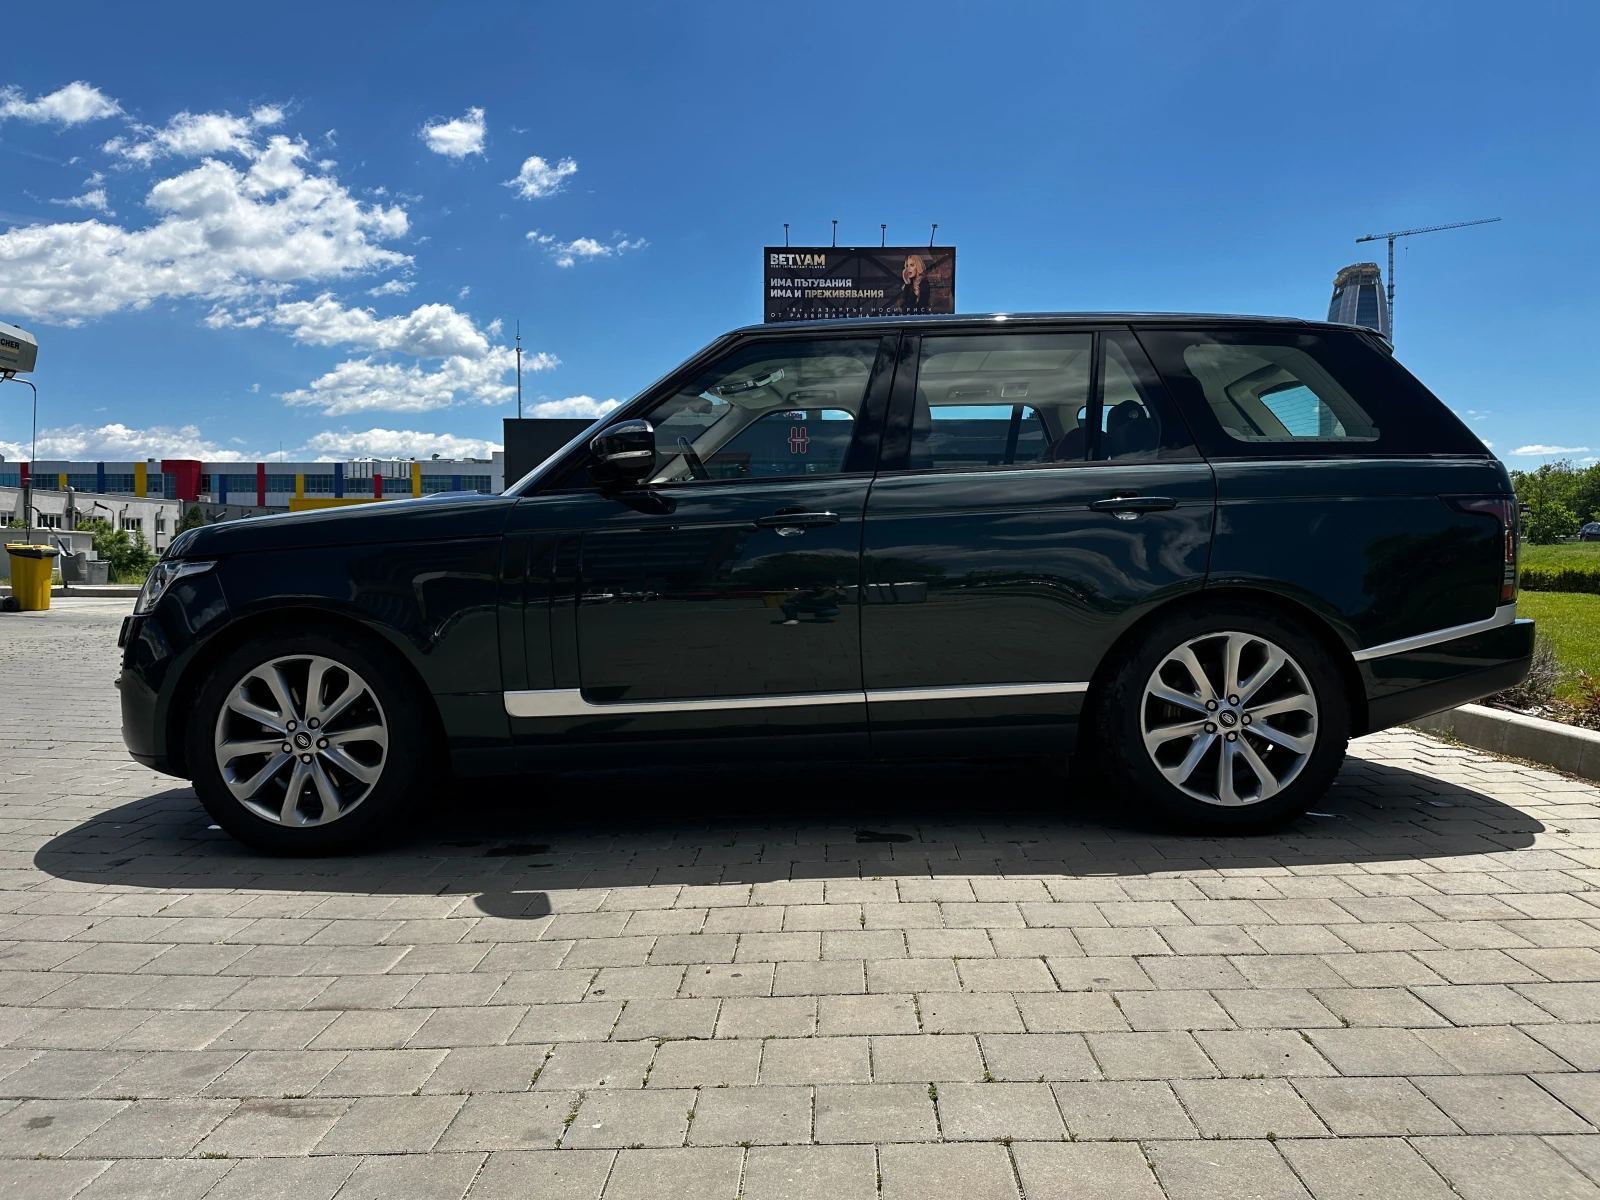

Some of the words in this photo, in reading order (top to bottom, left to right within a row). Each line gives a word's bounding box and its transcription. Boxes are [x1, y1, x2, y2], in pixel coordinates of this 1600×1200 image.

[770, 278, 792, 287] ИМА
[794, 278, 852, 287] ПЪТУВАНИЯ
[770, 289, 792, 298] ИМА
[794, 289, 801, 298] И
[804, 289, 884, 298] ПРЕЖИВЯВАНИЯ
